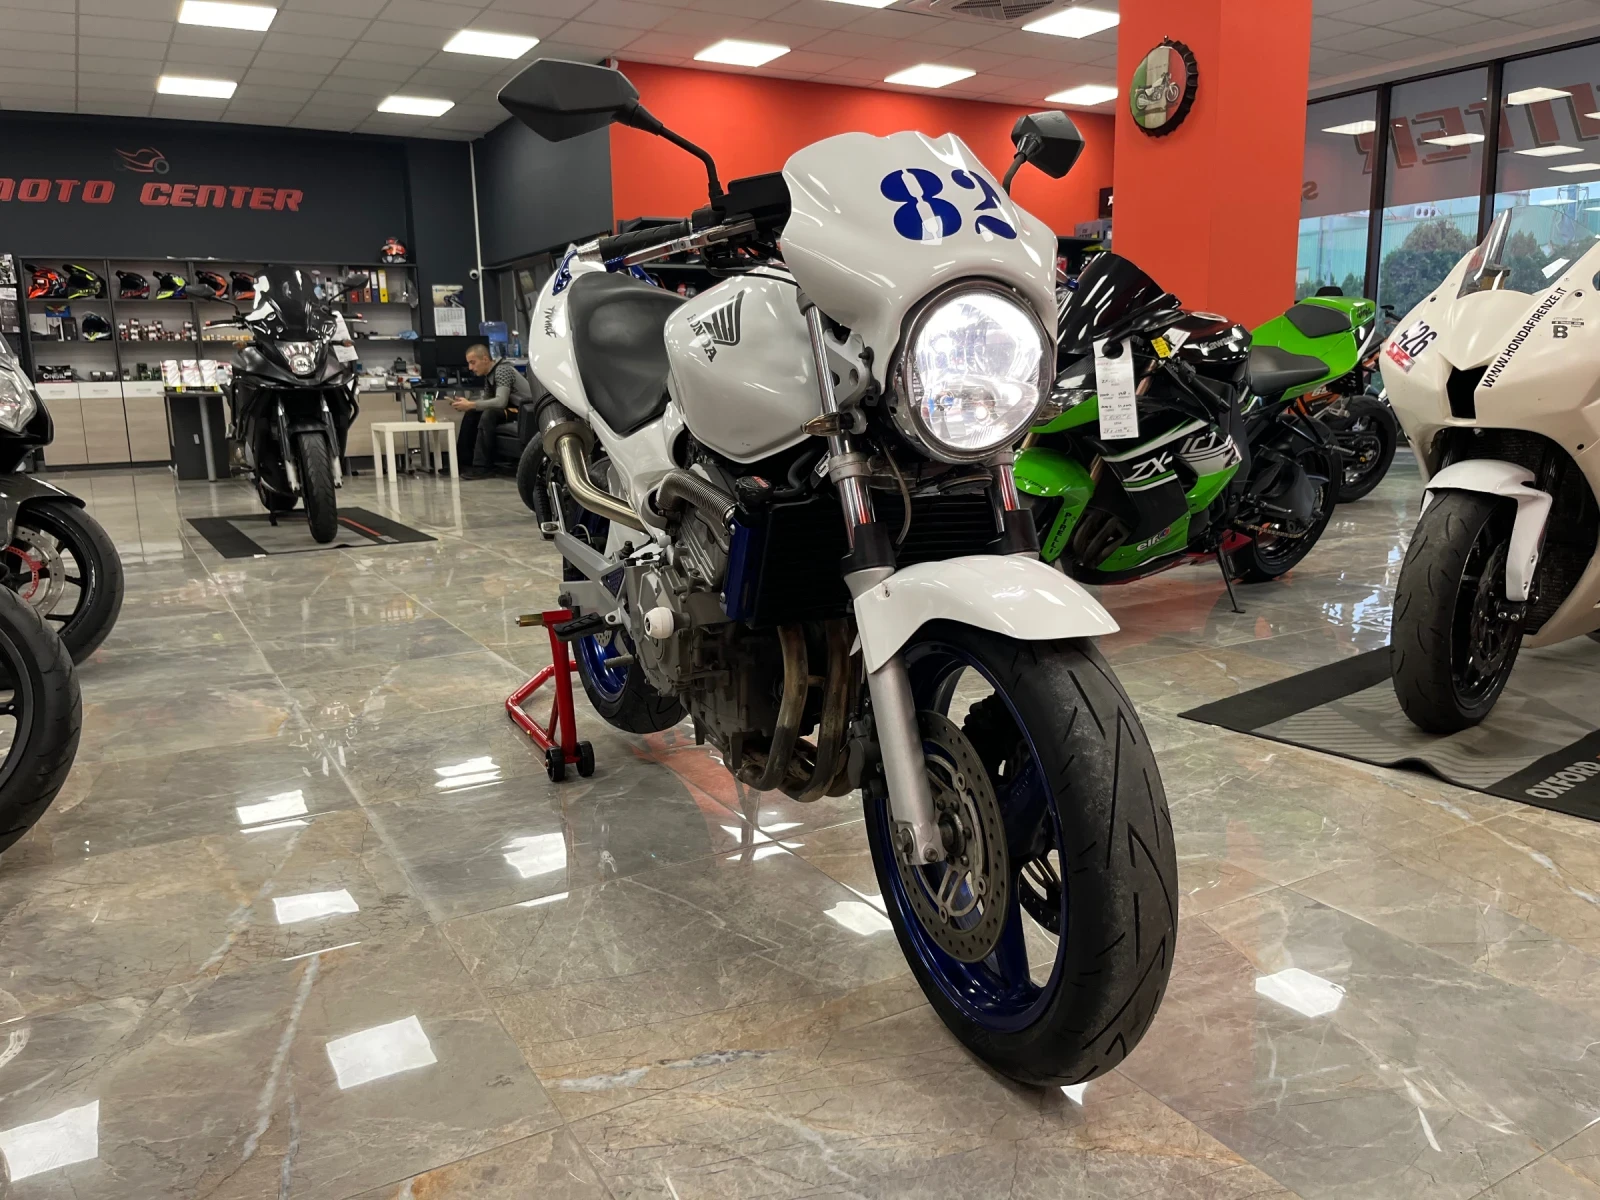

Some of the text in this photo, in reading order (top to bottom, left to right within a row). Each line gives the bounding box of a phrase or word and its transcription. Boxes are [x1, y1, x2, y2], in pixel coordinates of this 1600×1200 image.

[140, 182, 303, 212] CENTER
[880, 168, 1017, 240] 82
[1482, 286, 1567, 388] WWW.HONDAFIRENZE.IT
[1049, 512, 1072, 554] PIRELLI
[1525, 761, 1600, 799] OXFORD
